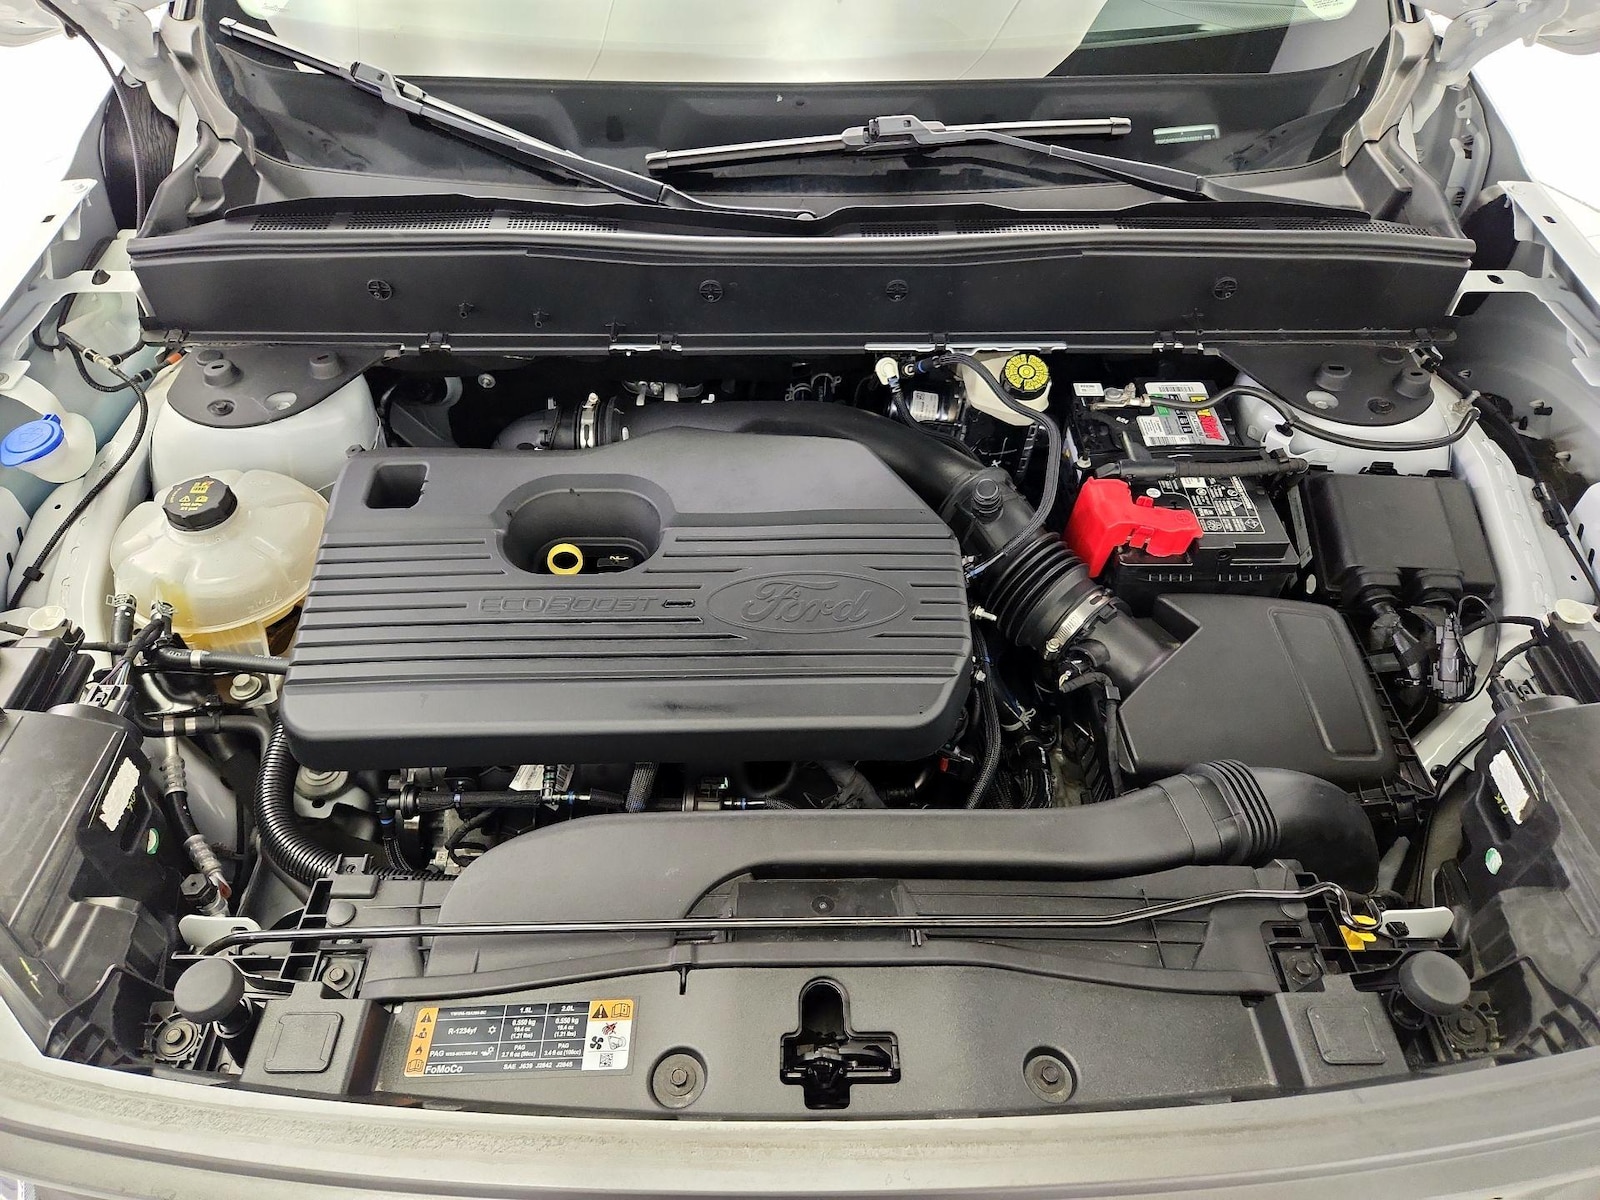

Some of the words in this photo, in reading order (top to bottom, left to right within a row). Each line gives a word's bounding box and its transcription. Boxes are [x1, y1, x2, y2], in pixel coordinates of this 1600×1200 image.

[741, 580, 872, 624] Ford
[528, 1019, 537, 1027] kg
[571, 1017, 580, 1025] kg
[447, 1027, 478, 1036] R-1234yf
[425, 1064, 463, 1074] FoMoCo
